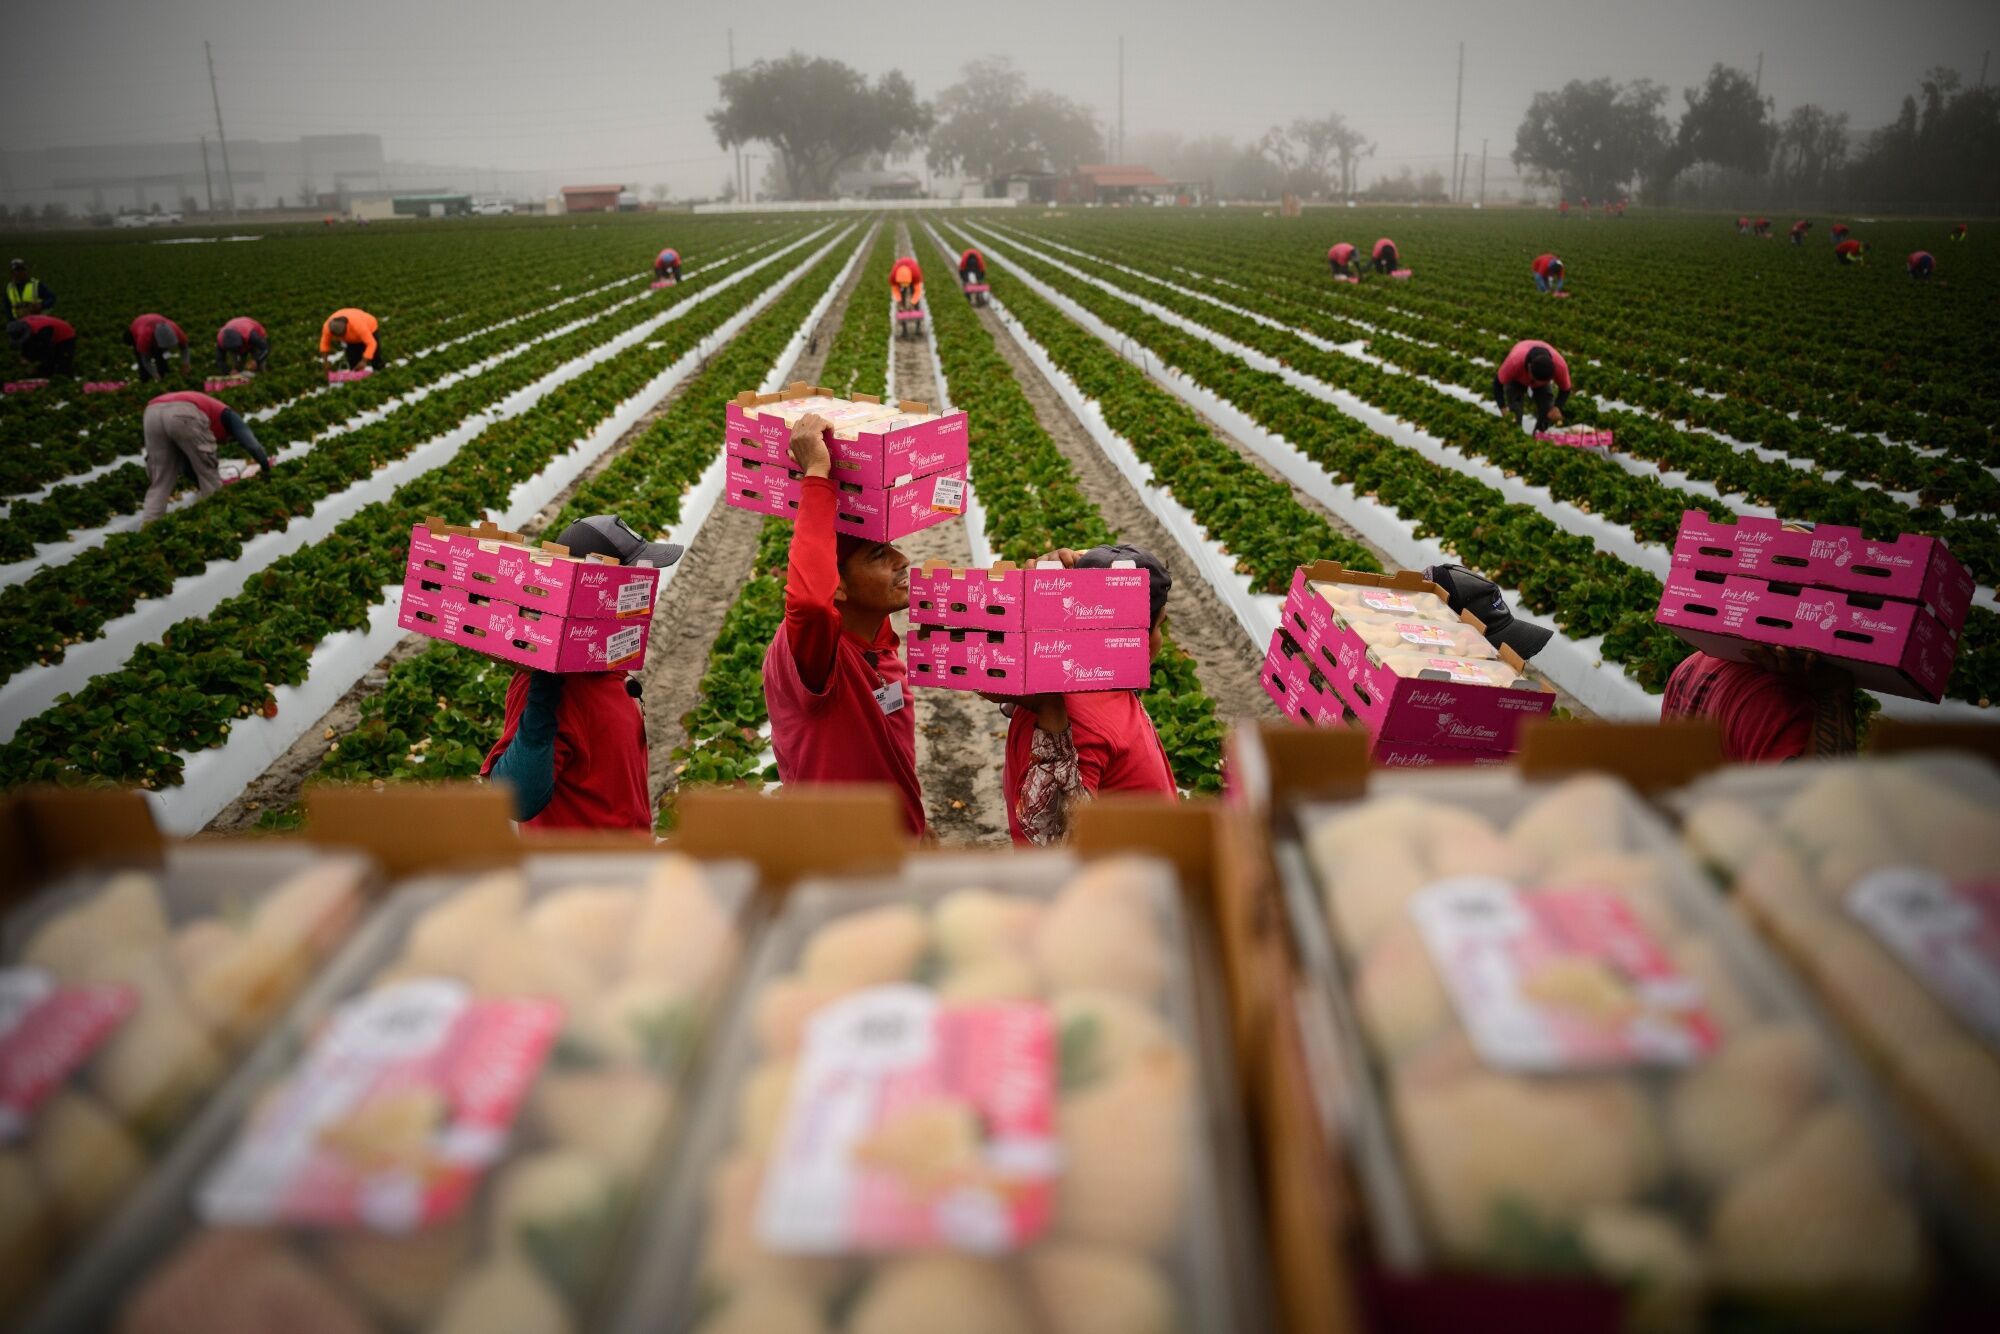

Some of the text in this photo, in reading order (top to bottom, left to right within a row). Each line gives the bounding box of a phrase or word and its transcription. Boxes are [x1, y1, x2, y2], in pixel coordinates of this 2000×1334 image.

[1810, 547, 1835, 559] READY
[1074, 604, 1115, 616] Wish Farms
[1795, 610, 1821, 621] READY
[1074, 666, 1115, 679] Wish Farms
[1450, 724, 1471, 735] Wish
[1471, 725, 1499, 738] Farms
